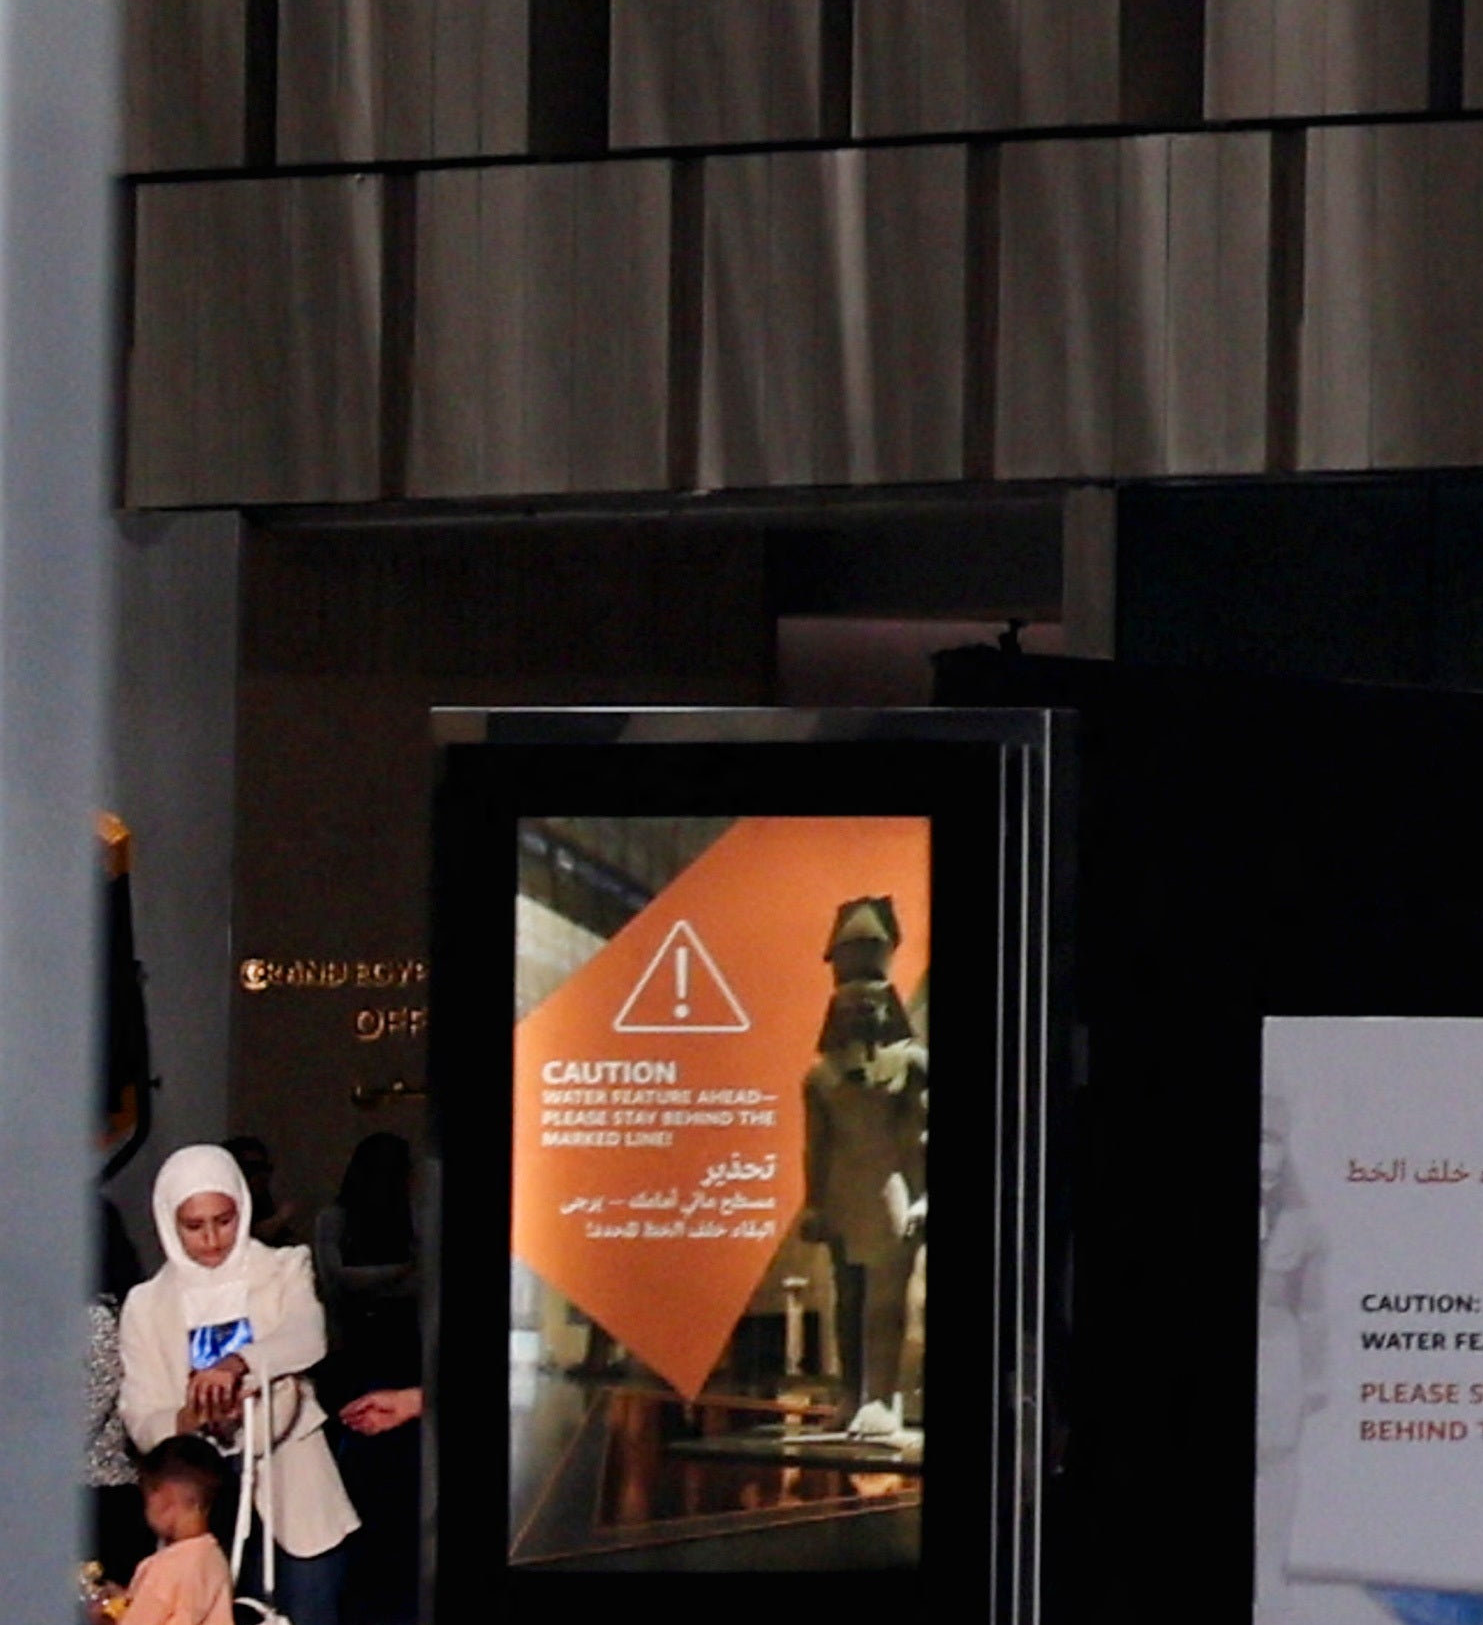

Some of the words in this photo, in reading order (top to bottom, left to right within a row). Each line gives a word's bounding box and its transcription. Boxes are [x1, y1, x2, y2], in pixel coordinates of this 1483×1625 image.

[542, 1060, 677, 1084] CAUTION
[542, 1089, 608, 1105] WATER
[610, 1089, 692, 1105] FEATURE
[542, 1110, 607, 1126] PLEASE
[612, 1110, 659, 1126] STAY
[661, 1110, 734, 1126] BEHIND
[739, 1110, 777, 1126] THE
[542, 1131, 622, 1147] MARKED
[700, 1152, 778, 1187] تحذير
[1346, 1158, 1406, 1184] الخط
[1412, 1158, 1471, 1185] خلف
[1361, 1293, 1482, 1314] CAUTION:
[1361, 1332, 1446, 1351] WATER
[1360, 1383, 1460, 1404] PLEASE
[1360, 1421, 1468, 1442] BEHIND
